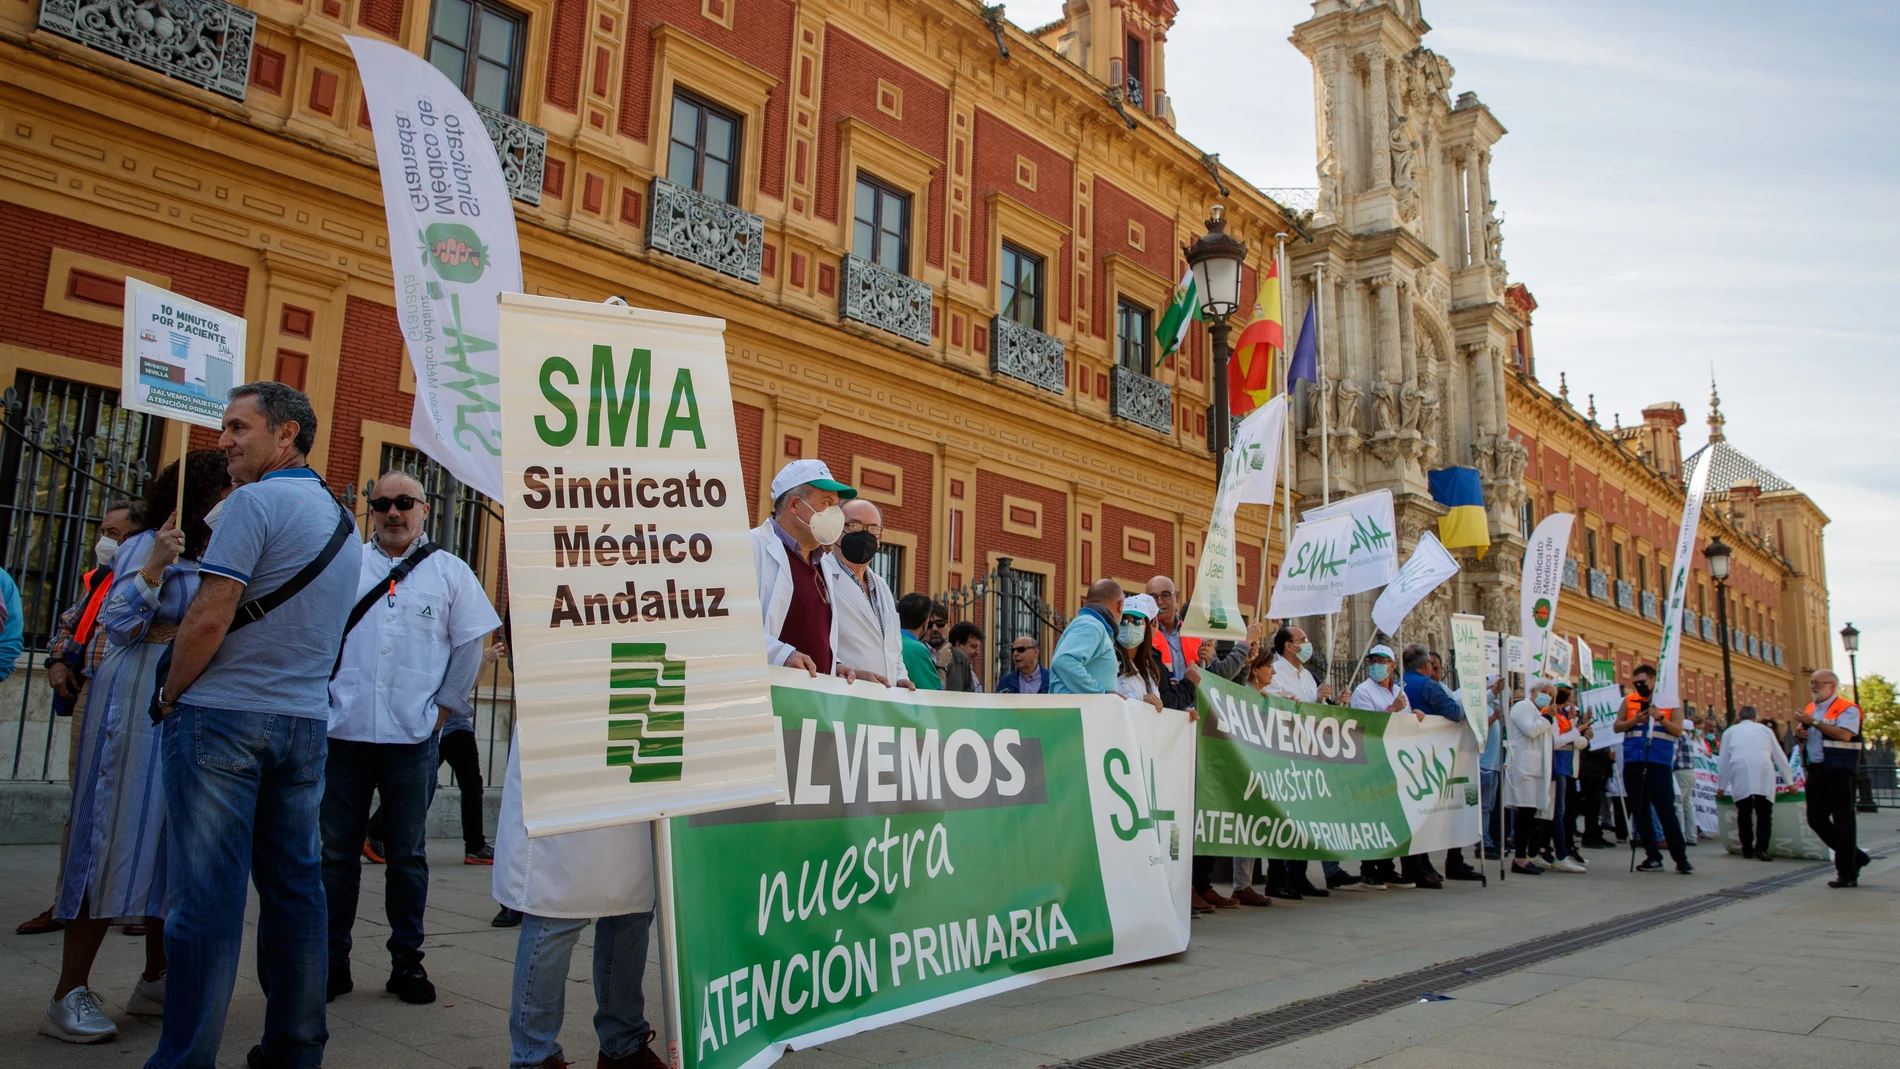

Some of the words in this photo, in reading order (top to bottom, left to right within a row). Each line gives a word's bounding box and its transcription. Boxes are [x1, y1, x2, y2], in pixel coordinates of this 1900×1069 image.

[152, 313, 174, 328] POR
[177, 321, 227, 345] PACIENTE
[161, 304, 173, 316] 10
[176, 310, 220, 332] MINUTOS
[144, 368, 169, 379] SEVILLA
[147, 395, 188, 411] ATENCIÓN
[192, 396, 224, 411] NUESTRA
[533, 344, 707, 450] SMA
[522, 465, 727, 510] Sindicato
[553, 523, 713, 568] Médico
[1546, 537, 1553, 548] de
[1533, 541, 1543, 594] Sindicato
[1543, 555, 1551, 595] Médico
[1550, 548, 1560, 596] Granada
[549, 578, 730, 628] Andaluz
[1210, 687, 1358, 760] SALVEMOS
[1244, 760, 1331, 802] nuestra
[1194, 809, 1309, 850] ATENCIÓN
[1311, 821, 1398, 851] PRIMARIA
[757, 817, 955, 936] nuestra
[698, 929, 878, 1062] ATENCIÓN
[889, 902, 1079, 988] PRIMARIA
